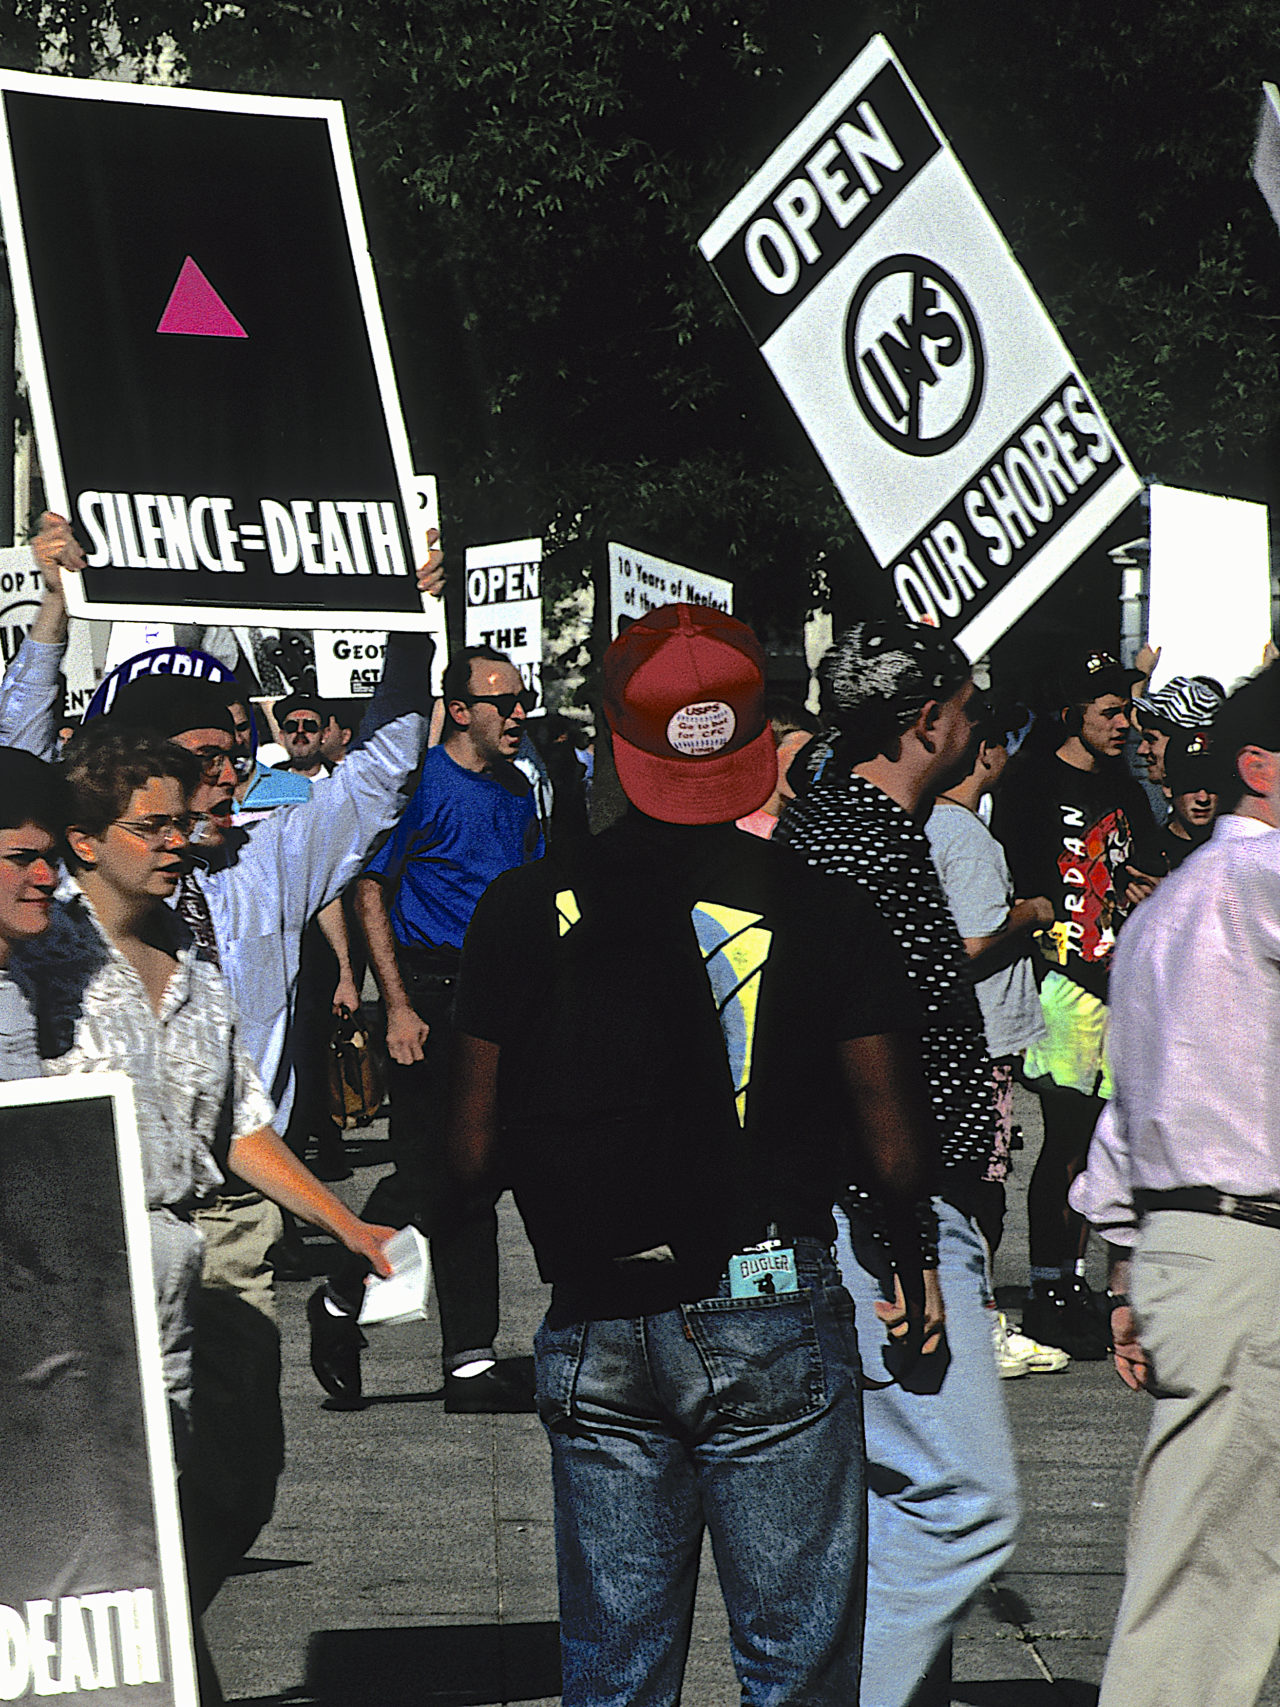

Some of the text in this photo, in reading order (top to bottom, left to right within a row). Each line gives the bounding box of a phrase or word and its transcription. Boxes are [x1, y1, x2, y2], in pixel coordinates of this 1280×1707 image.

[744, 101, 905, 295] OPEN
[861, 283, 963, 423] INS
[893, 385, 1113, 628] OUR SHORES
[78, 490, 409, 576] SILENCE=DEATH
[469, 562, 541, 604] OPEN
[618, 556, 631, 577] 10
[635, 563, 666, 592] Years
[670, 580, 682, 598] of
[625, 587, 635, 606] of
[480, 627, 528, 649] THE
[349, 669, 380, 682] ACT
[678, 722, 694, 730] Go
[685, 703, 720, 716] USPS
[1059, 805, 1087, 958] JORDAN
[740, 1254, 789, 1278] BUGLER
